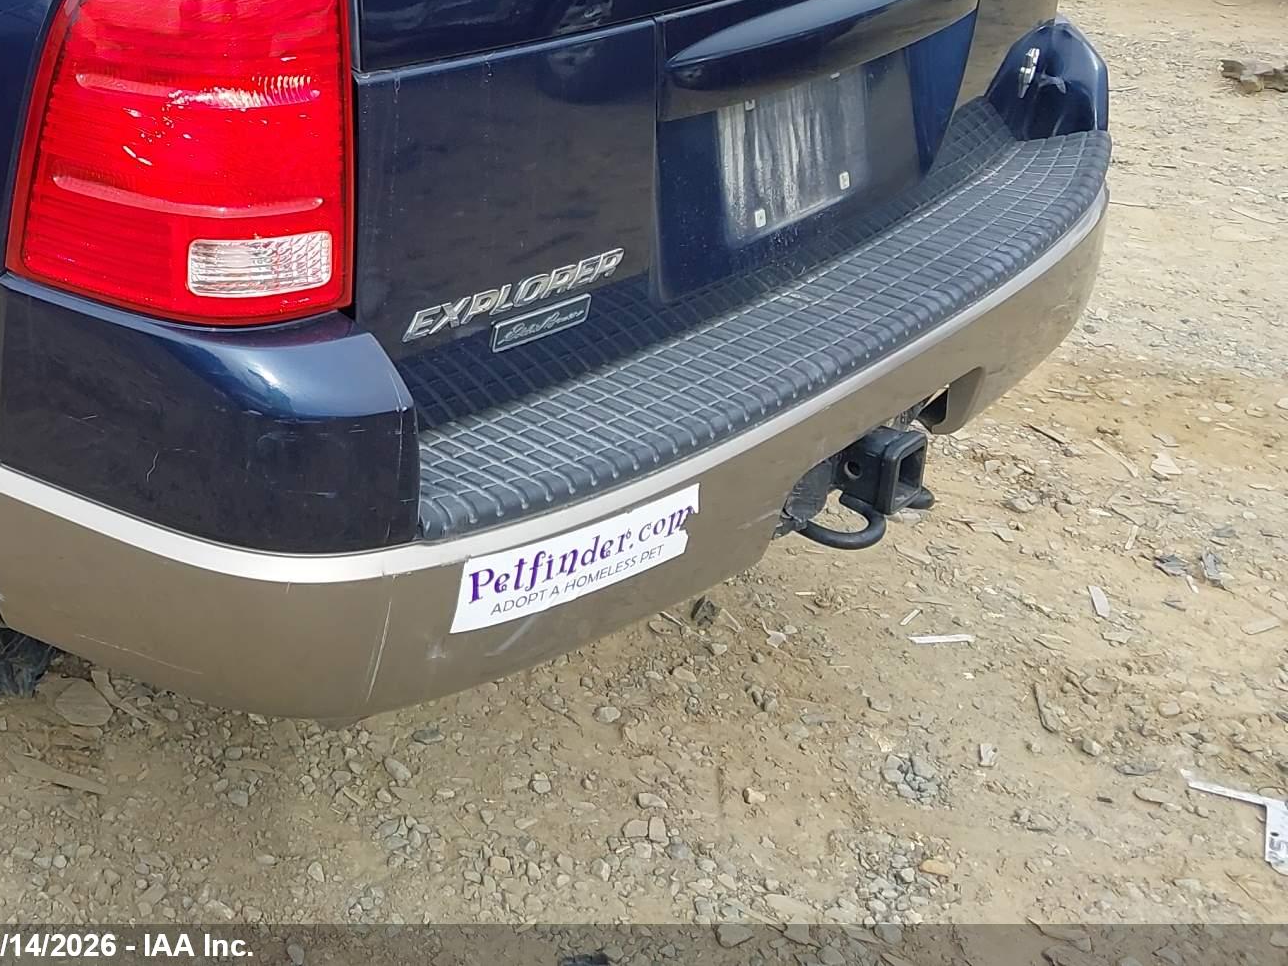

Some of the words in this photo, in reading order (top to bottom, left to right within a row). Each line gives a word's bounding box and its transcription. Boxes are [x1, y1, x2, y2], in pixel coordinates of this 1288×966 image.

[401, 246, 626, 344] EXPLORER
[490, 588, 553, 616] ADOPT
[549, 585, 561, 597] A
[564, 553, 638, 593] HOMELESS
[639, 543, 665, 564] PET
